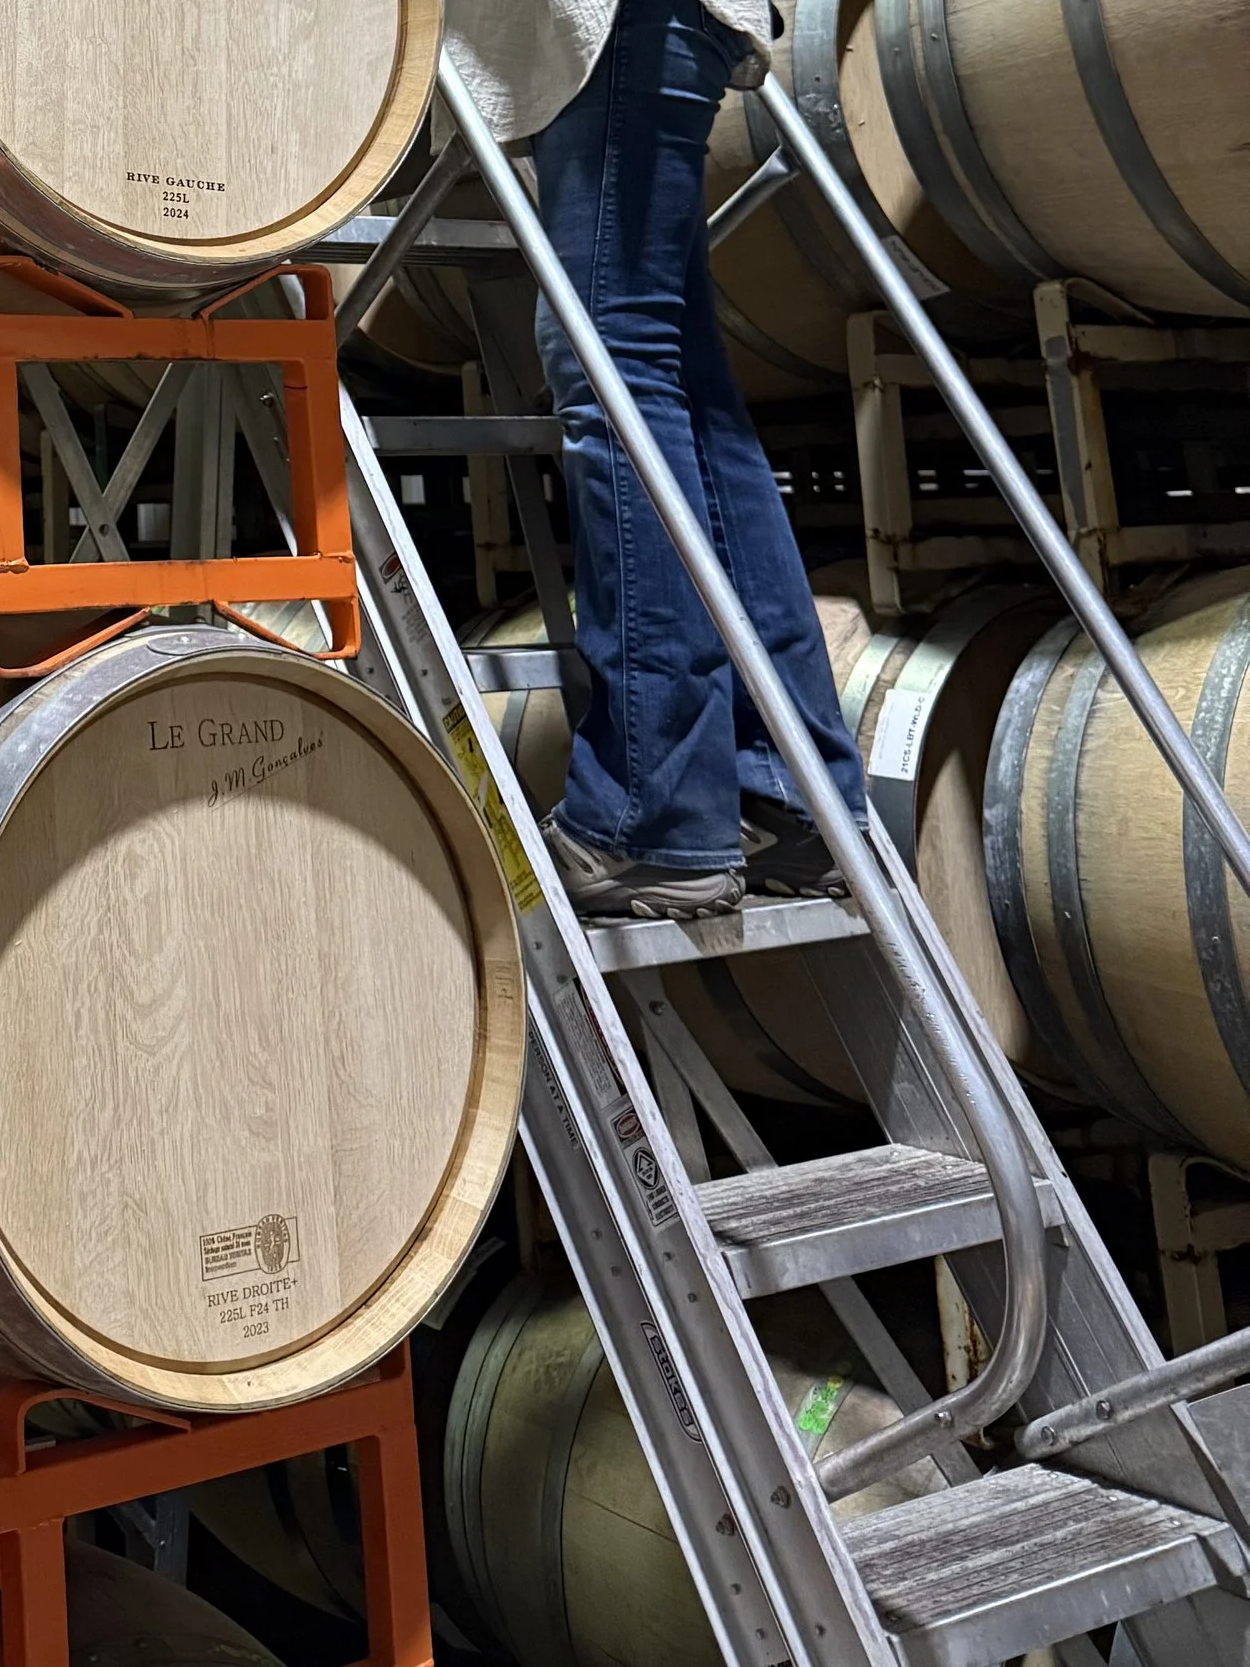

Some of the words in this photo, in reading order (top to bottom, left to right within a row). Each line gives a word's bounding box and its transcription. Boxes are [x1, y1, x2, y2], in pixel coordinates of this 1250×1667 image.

[126, 172, 160, 184] RIVE
[165, 176, 226, 192] GAUCHE
[162, 191, 190, 204] 225L
[163, 207, 189, 219] 2024
[147, 720, 185, 751] LE
[198, 718, 284, 748] GRAND
[207, 1290, 239, 1308] RIVE
[243, 1277, 299, 1300] DROITE+
[219, 1307, 247, 1324] 225L
[250, 1302, 269, 1317] F24
[272, 1297, 290, 1312] TH
[243, 1321, 269, 1338] 2023
